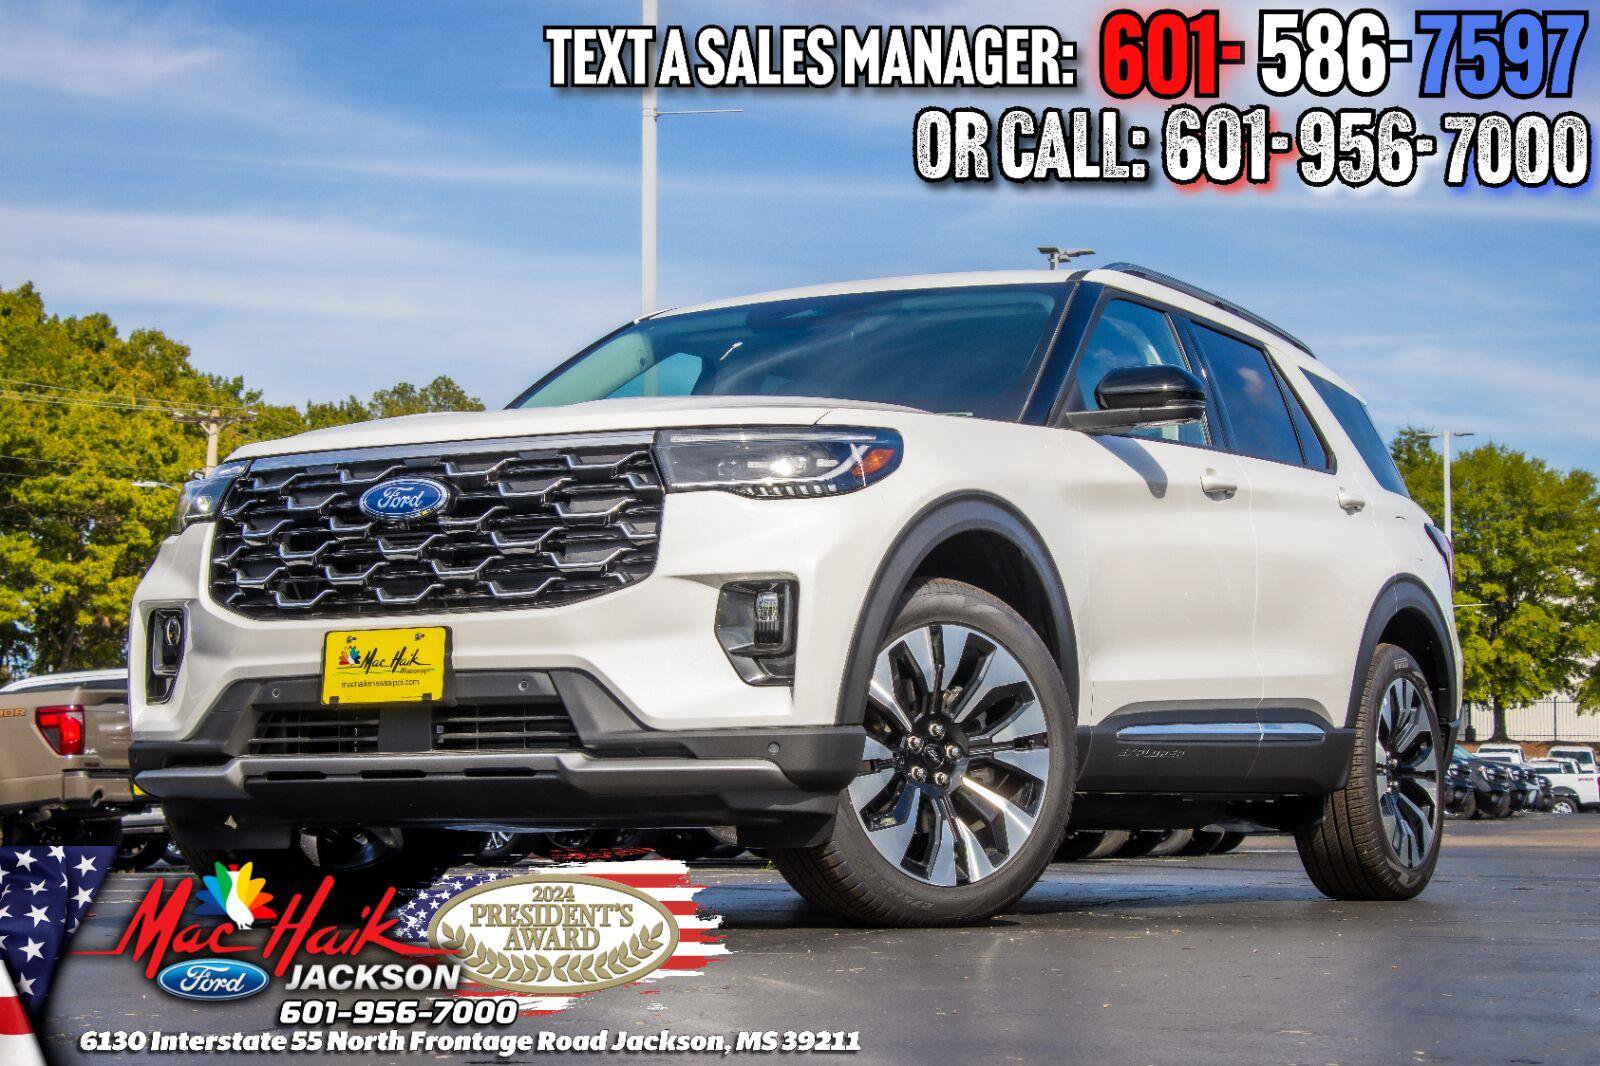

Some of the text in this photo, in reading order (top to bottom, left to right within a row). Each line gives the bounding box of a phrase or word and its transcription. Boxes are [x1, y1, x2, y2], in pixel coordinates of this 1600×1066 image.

[377, 487, 425, 508] Ford
[361, 647, 431, 674] Mac Haik
